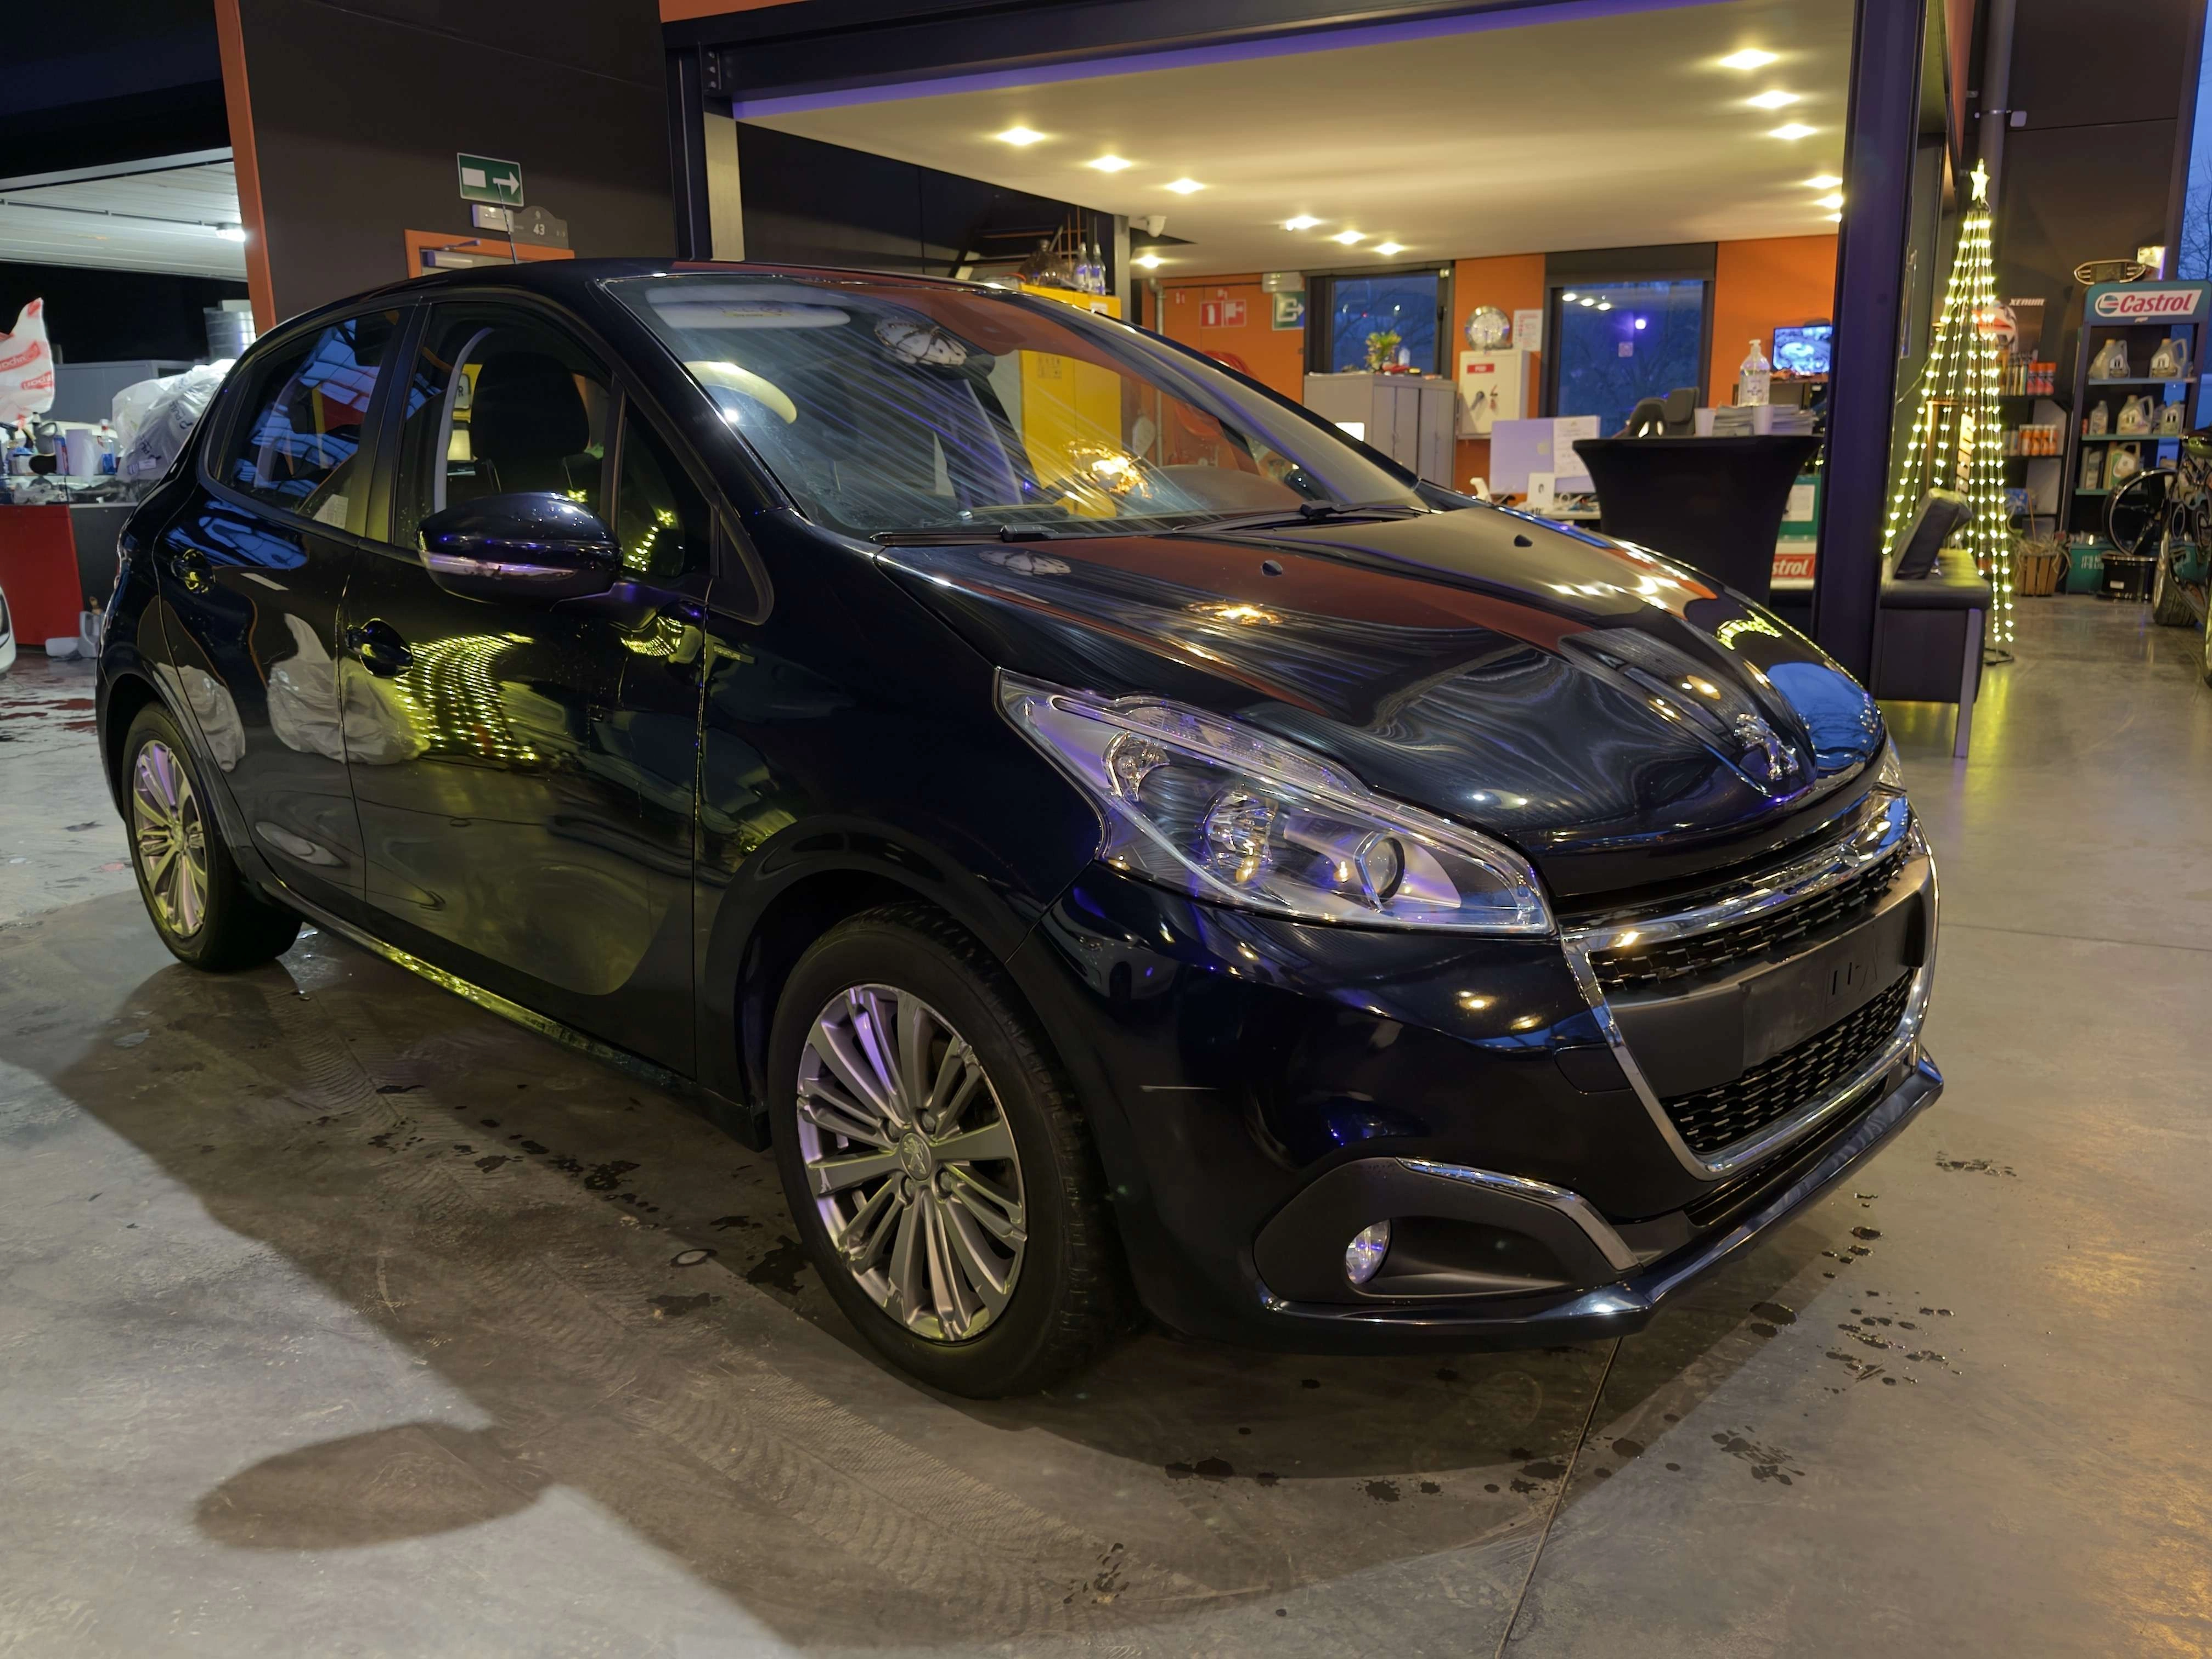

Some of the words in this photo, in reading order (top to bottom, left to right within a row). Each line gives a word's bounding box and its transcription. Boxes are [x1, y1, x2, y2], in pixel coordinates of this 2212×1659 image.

[533, 223, 545, 235] 43
[2120, 293, 2193, 313] Castrol
[1773, 560, 1809, 575] strol
